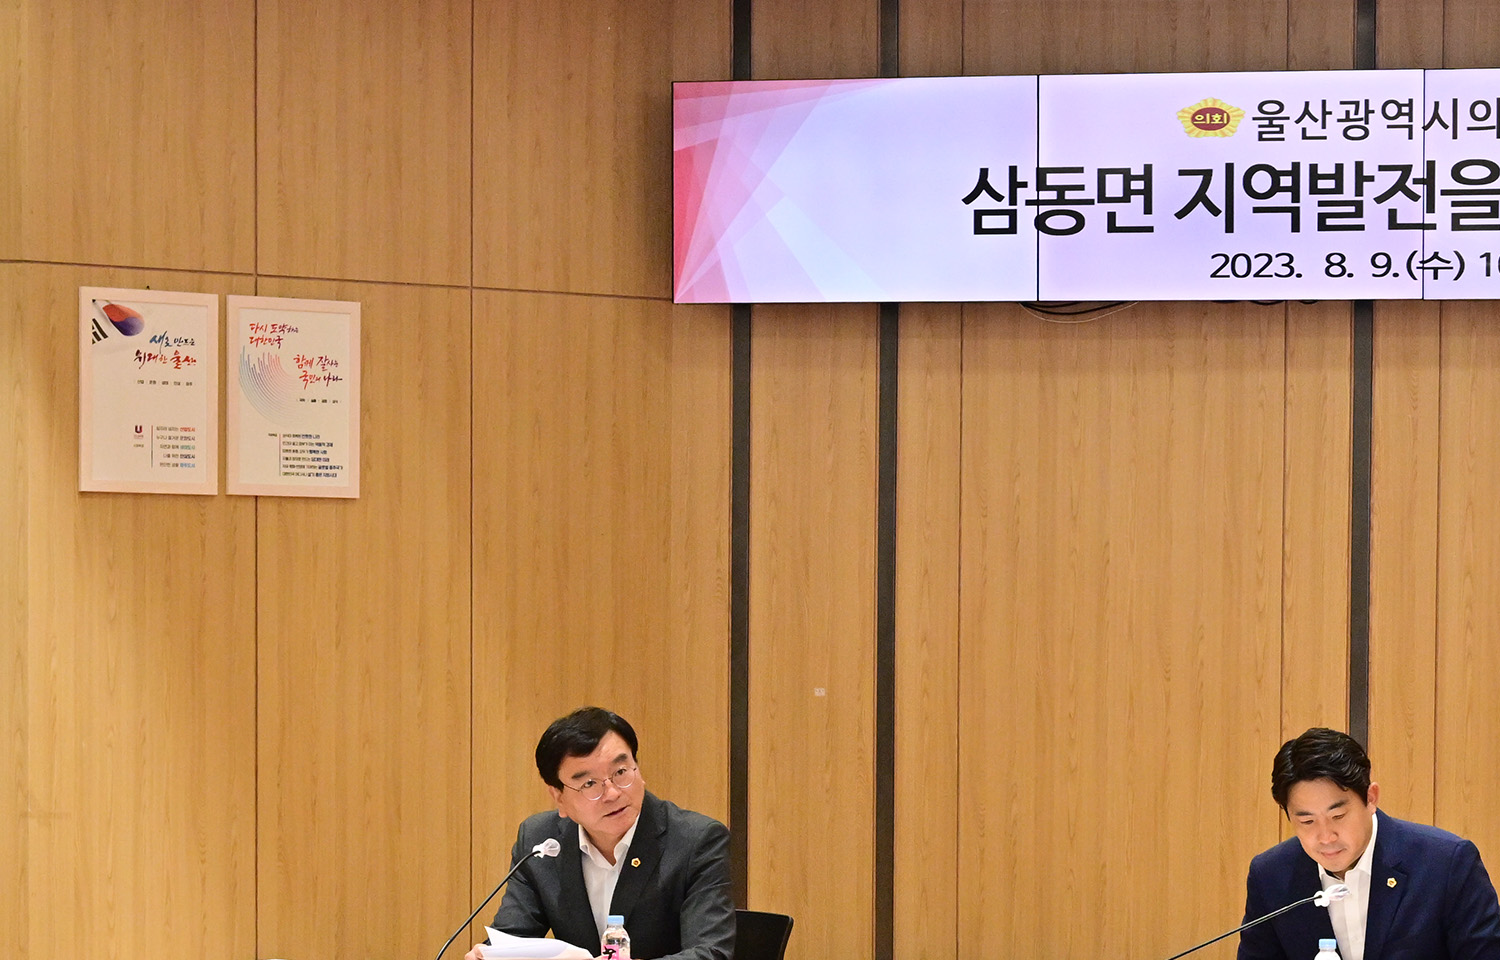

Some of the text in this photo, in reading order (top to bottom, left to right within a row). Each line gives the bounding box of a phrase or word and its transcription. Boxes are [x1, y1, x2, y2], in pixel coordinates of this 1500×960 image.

[1192, 112, 1228, 124] 의회
[961, 164, 1155, 237] 삼동면
[1209, 252, 1303, 279] 2023.
[1324, 252, 1354, 278] 8.
